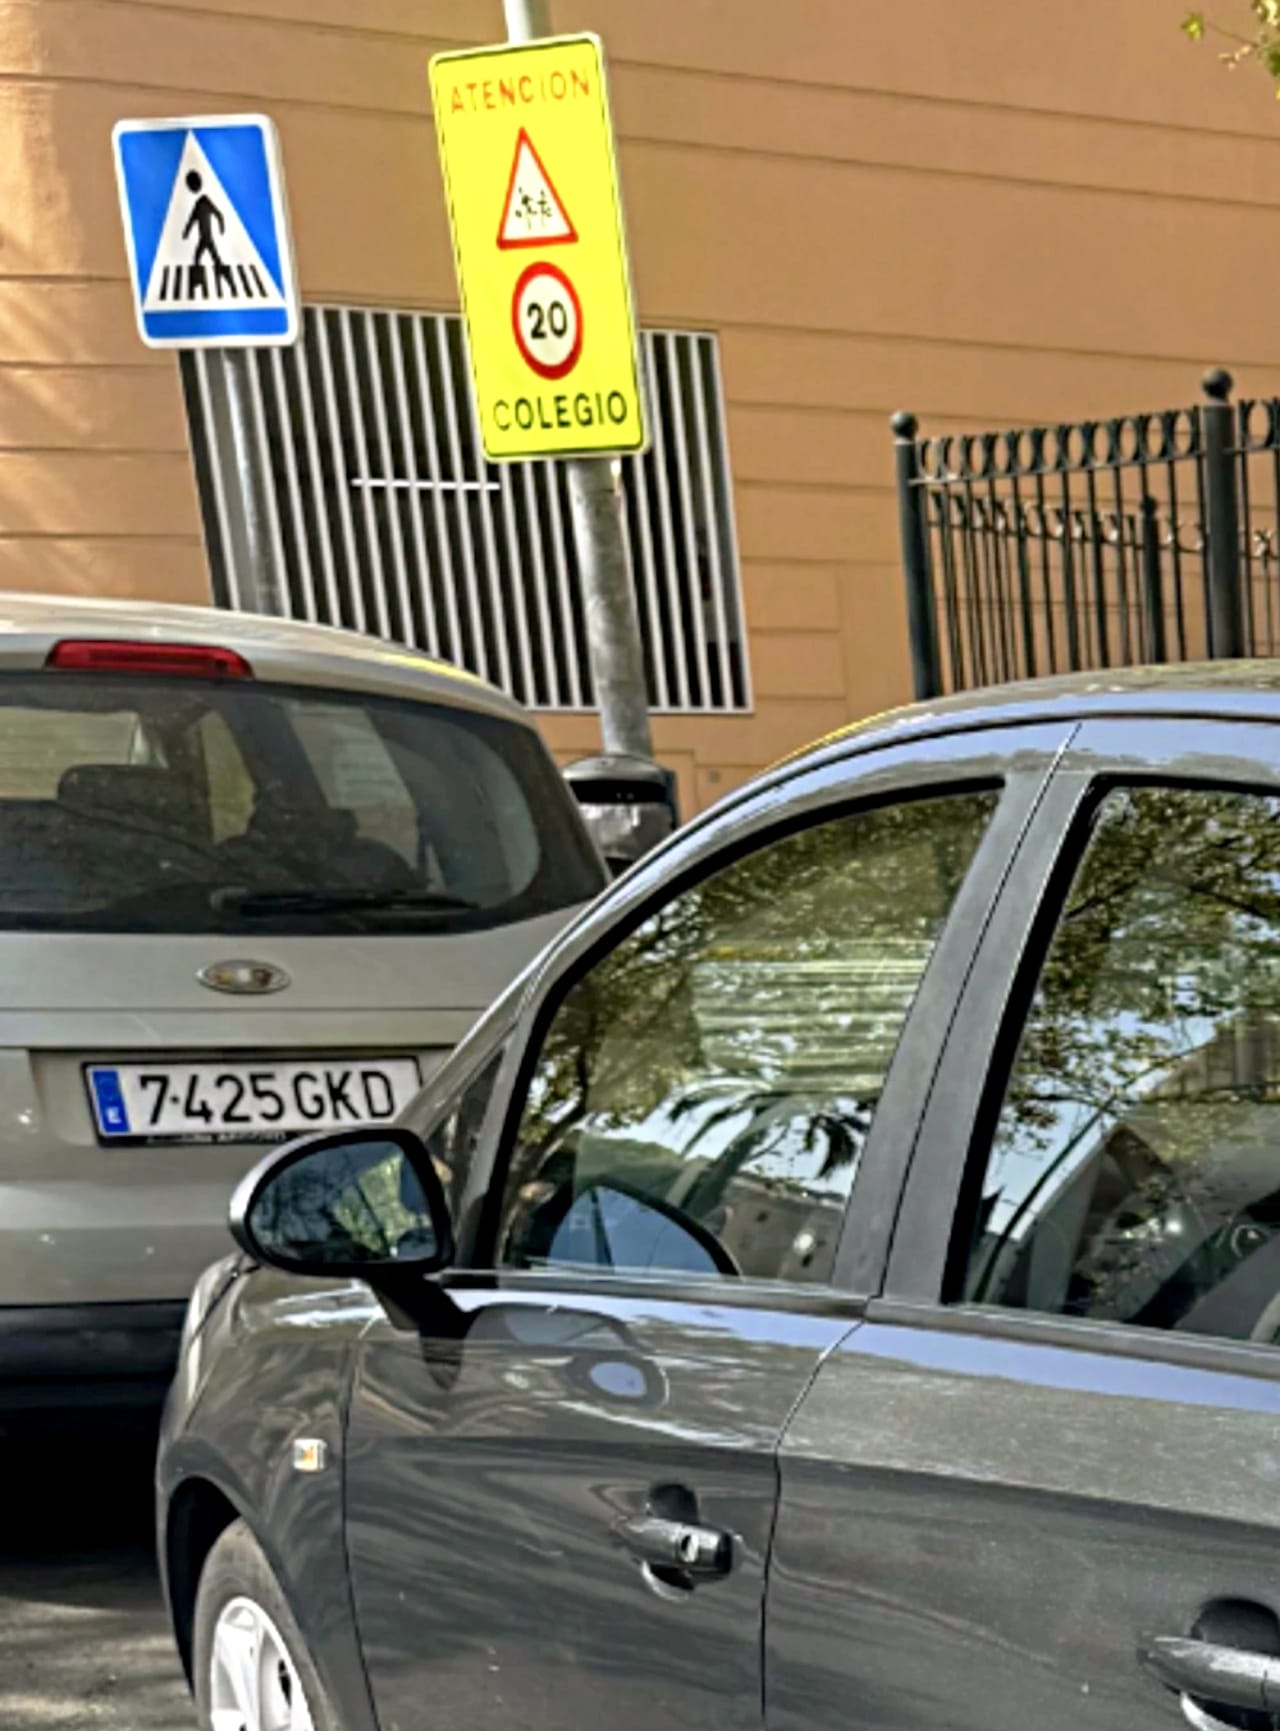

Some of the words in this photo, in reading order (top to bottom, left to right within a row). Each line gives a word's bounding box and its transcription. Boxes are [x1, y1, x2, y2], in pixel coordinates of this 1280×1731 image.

[451, 69, 590, 114] ATENCION
[526, 301, 568, 340] 20
[493, 390, 627, 431] COLEGIO
